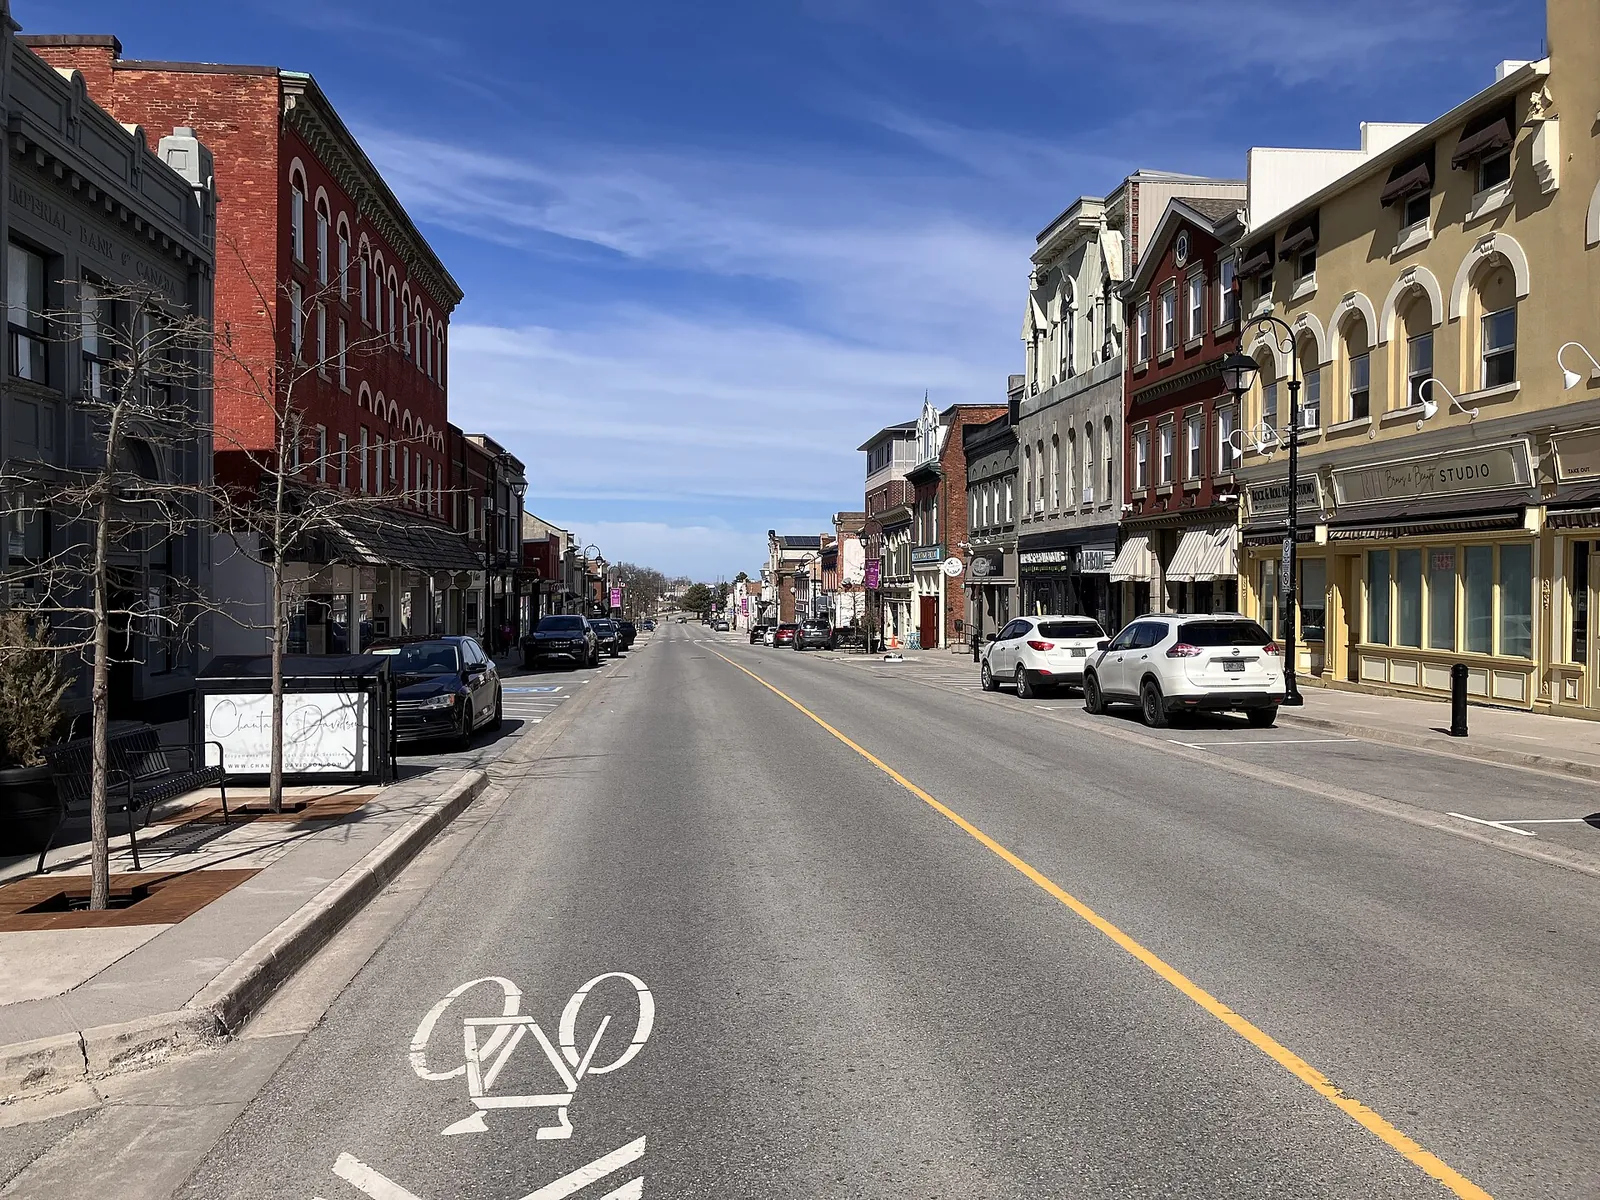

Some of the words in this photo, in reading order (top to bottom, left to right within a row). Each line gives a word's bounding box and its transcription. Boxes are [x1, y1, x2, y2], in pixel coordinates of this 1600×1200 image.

[9, 183, 72, 236] IMPERIAL
[80, 226, 115, 261] BANK
[136, 260, 176, 297] CANADA
[1440, 463, 1490, 482] STUDIO
[209, 699, 272, 738] Chanta
